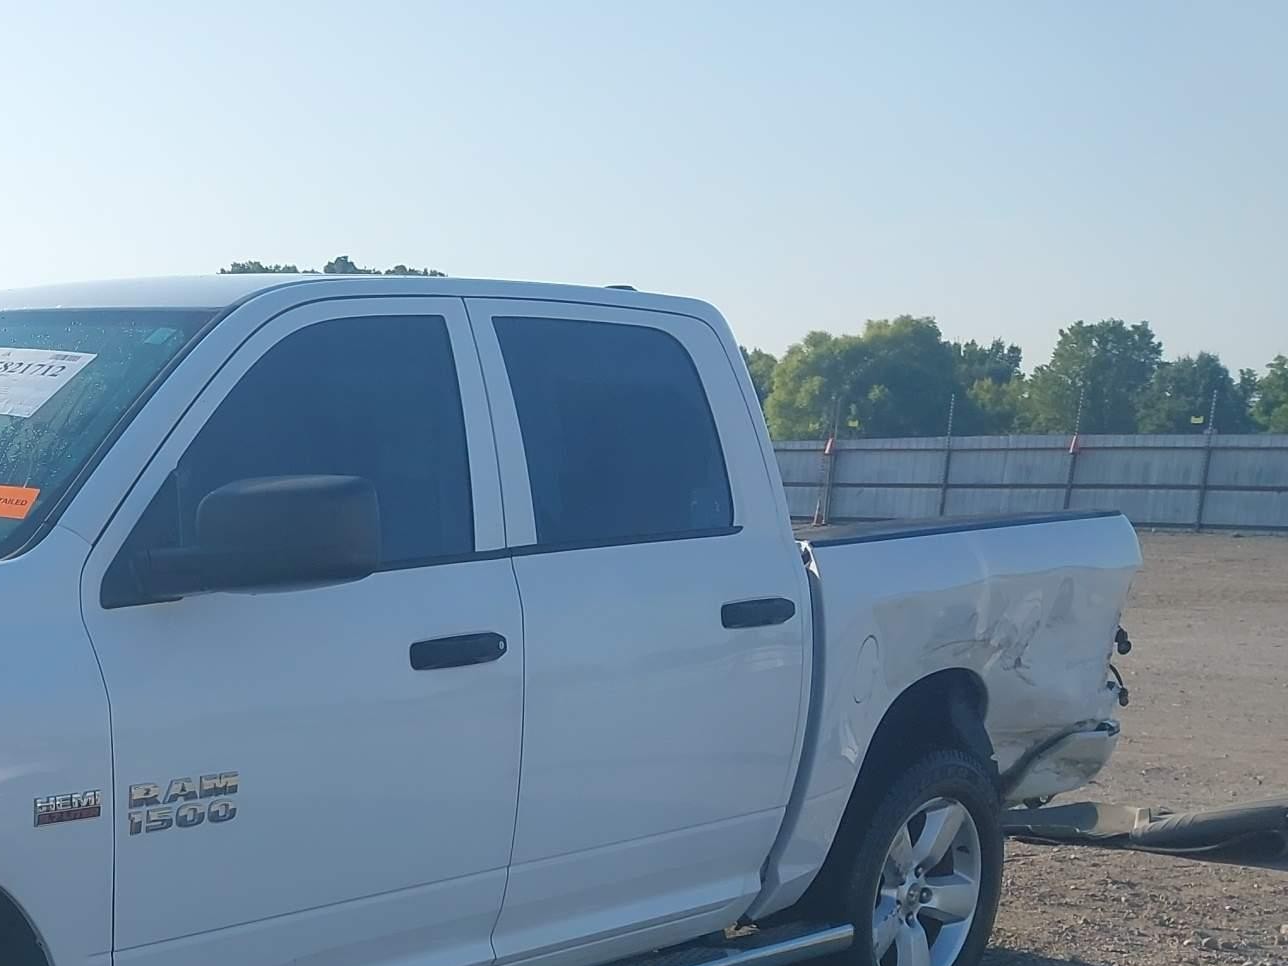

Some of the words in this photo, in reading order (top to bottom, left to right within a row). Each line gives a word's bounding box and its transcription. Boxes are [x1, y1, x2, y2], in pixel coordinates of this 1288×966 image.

[33, 789, 102, 813] HEMI
[129, 771, 239, 809] RAM
[128, 799, 238, 836] 1500
